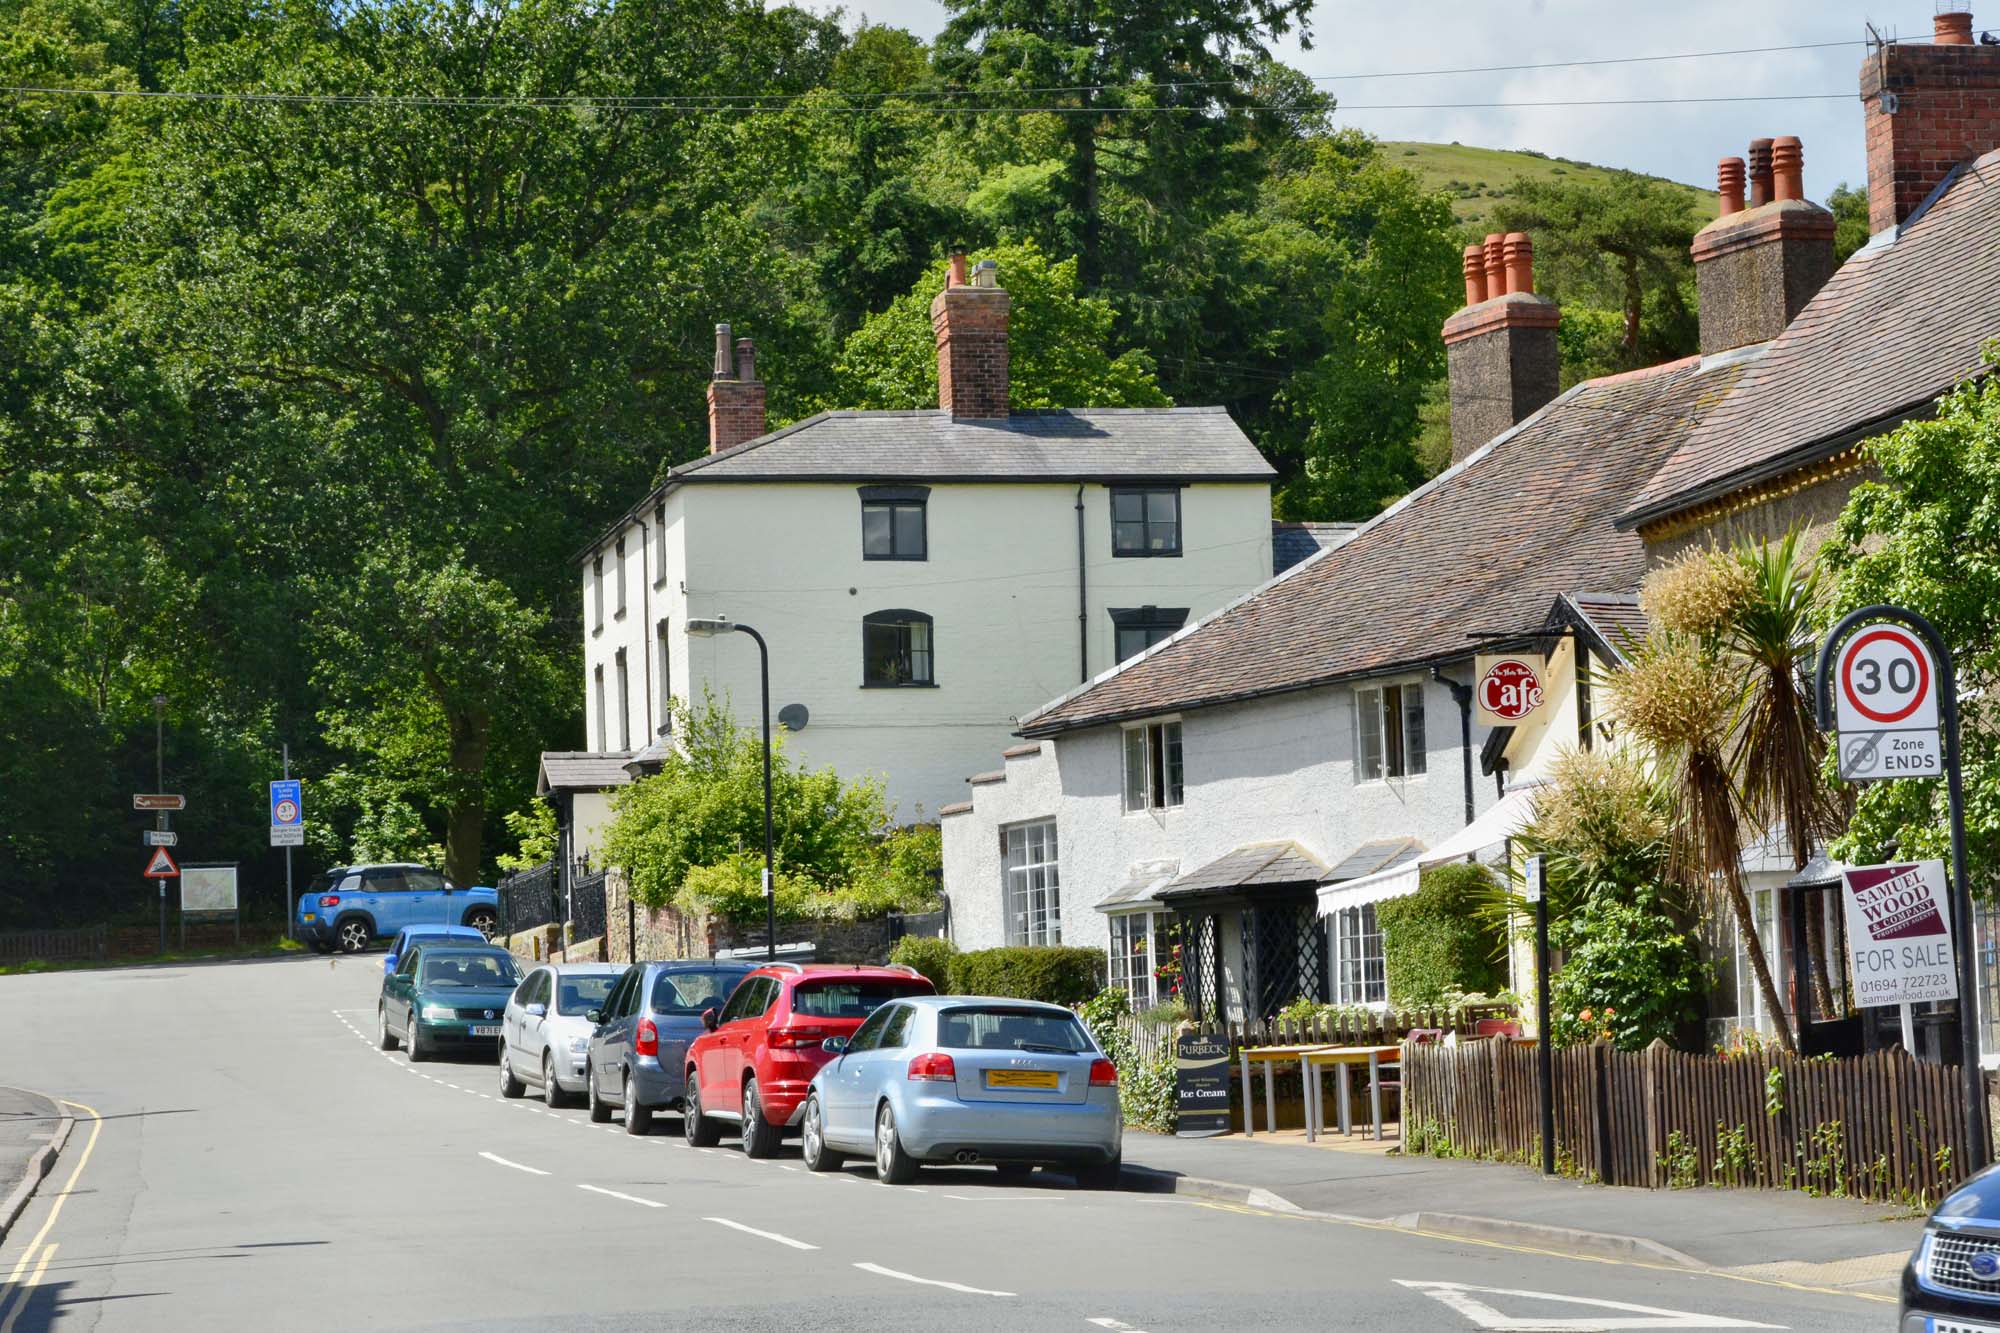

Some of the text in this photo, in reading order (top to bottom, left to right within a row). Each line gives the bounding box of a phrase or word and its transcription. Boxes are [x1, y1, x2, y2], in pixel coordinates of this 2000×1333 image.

[1855, 657, 1916, 696] 30
[1479, 676, 1544, 716] Cafe
[1892, 739, 1925, 750] Zone
[1850, 747, 1874, 763] 20
[1885, 754, 1935, 770] ENDS
[1855, 869, 1925, 908] SAMUEL
[1862, 884, 1930, 922] WOOD
[1872, 901, 1933, 932] & COMPANY
[1876, 921, 1910, 939] PROPERTY
[1856, 943, 1949, 973] FOR SALE
[1860, 973, 1948, 993] 01694 722723
[1862, 987, 1951, 1005] samuelwood.co.uk
[1178, 1044, 1226, 1056] PURBECK
[1180, 1088, 1227, 1098] Ice Cream
